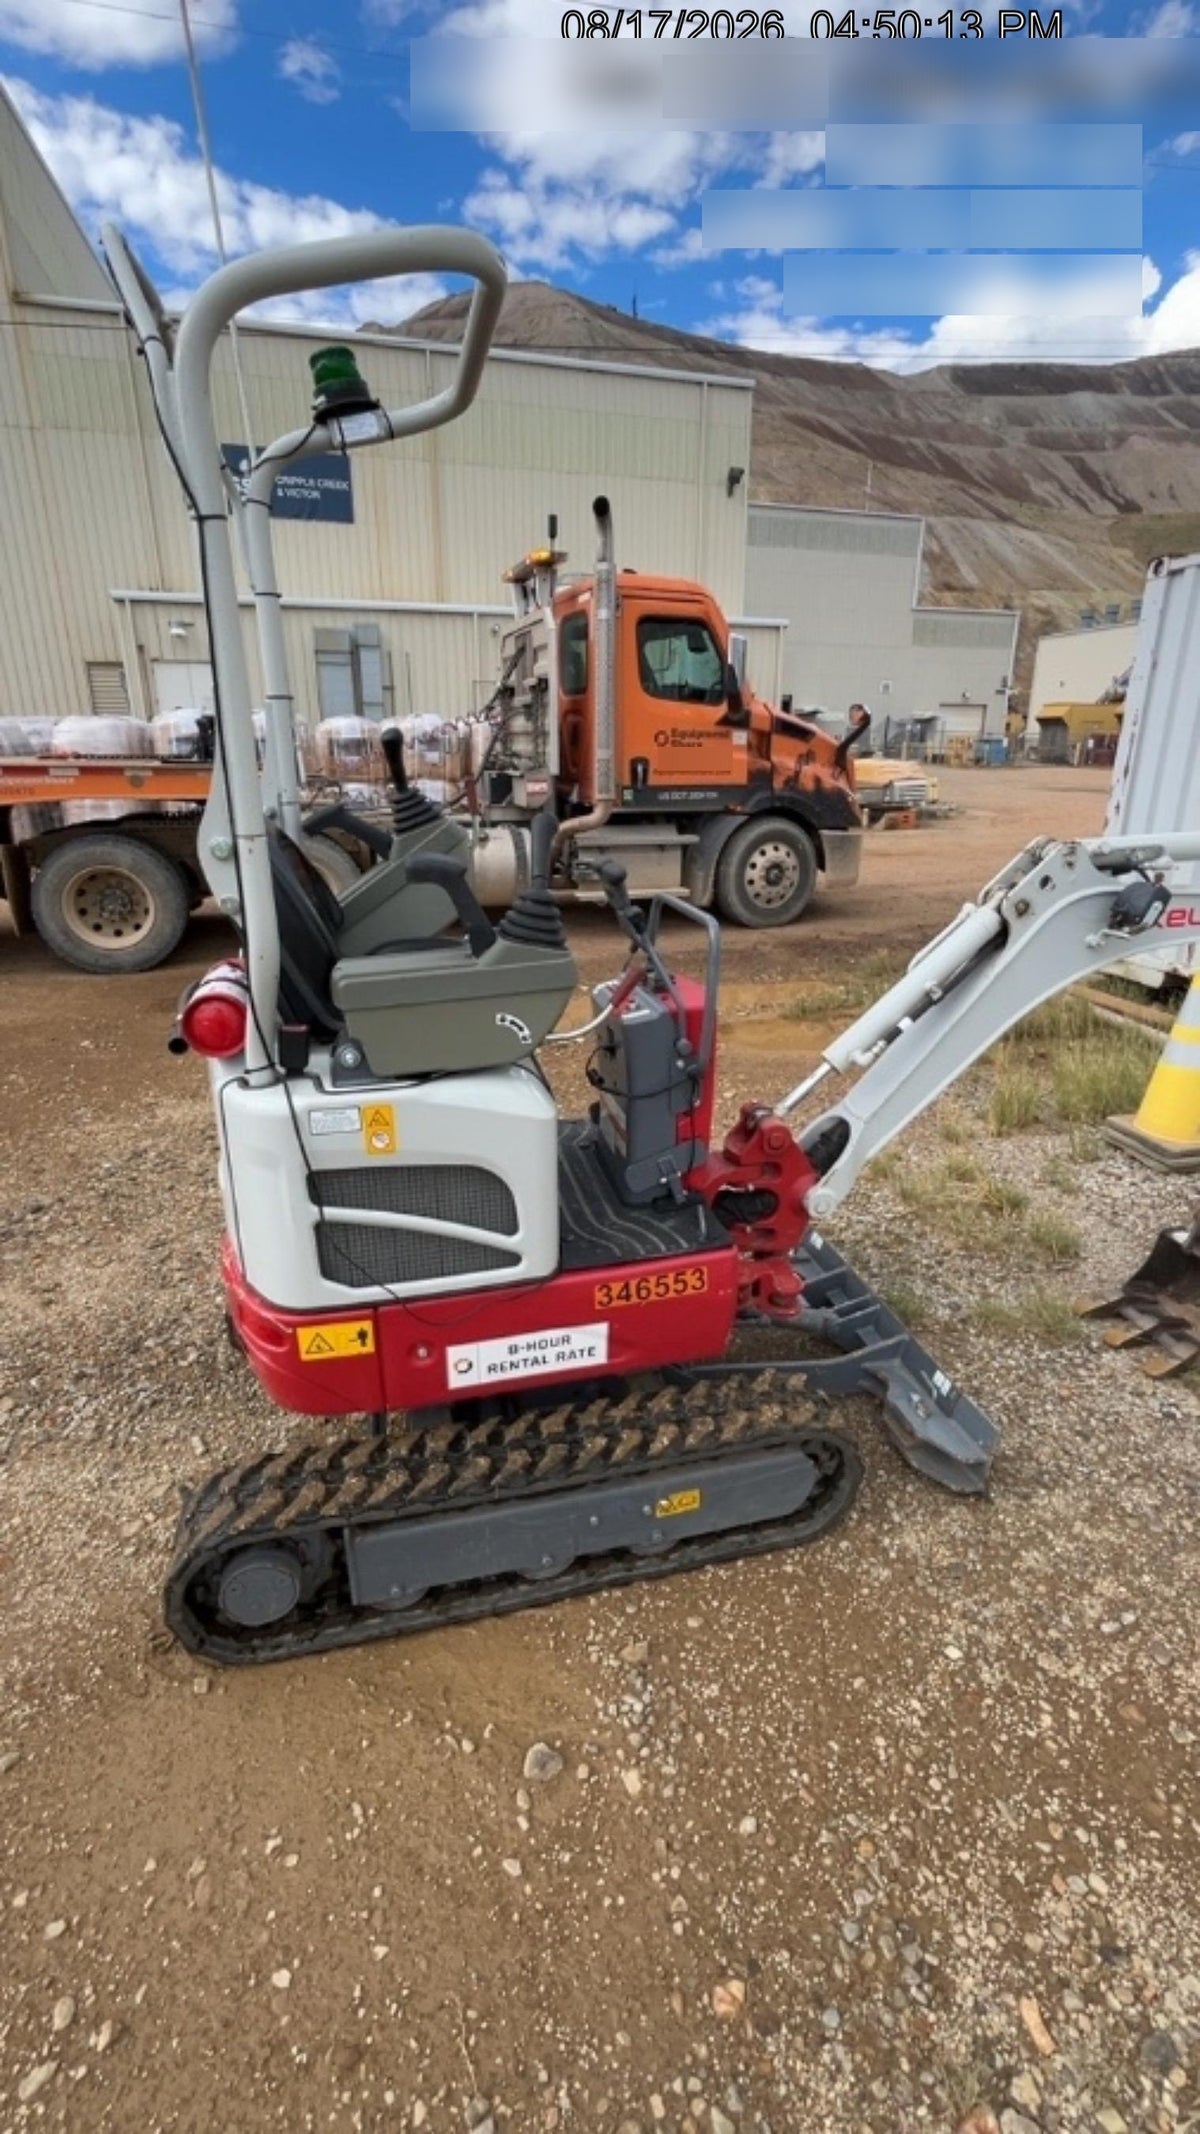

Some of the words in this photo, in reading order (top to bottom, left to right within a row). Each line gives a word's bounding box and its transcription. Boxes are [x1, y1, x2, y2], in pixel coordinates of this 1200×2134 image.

[275, 475, 316, 488] CRIPPLE
[317, 478, 350, 491] CREEK
[285, 489, 321, 499] VICTOR
[597, 1268, 706, 1308] 346553
[507, 1334, 572, 1356] 8-HOUR
[487, 1356, 551, 1375] RENTAL
[556, 1346, 597, 1363] RATE
